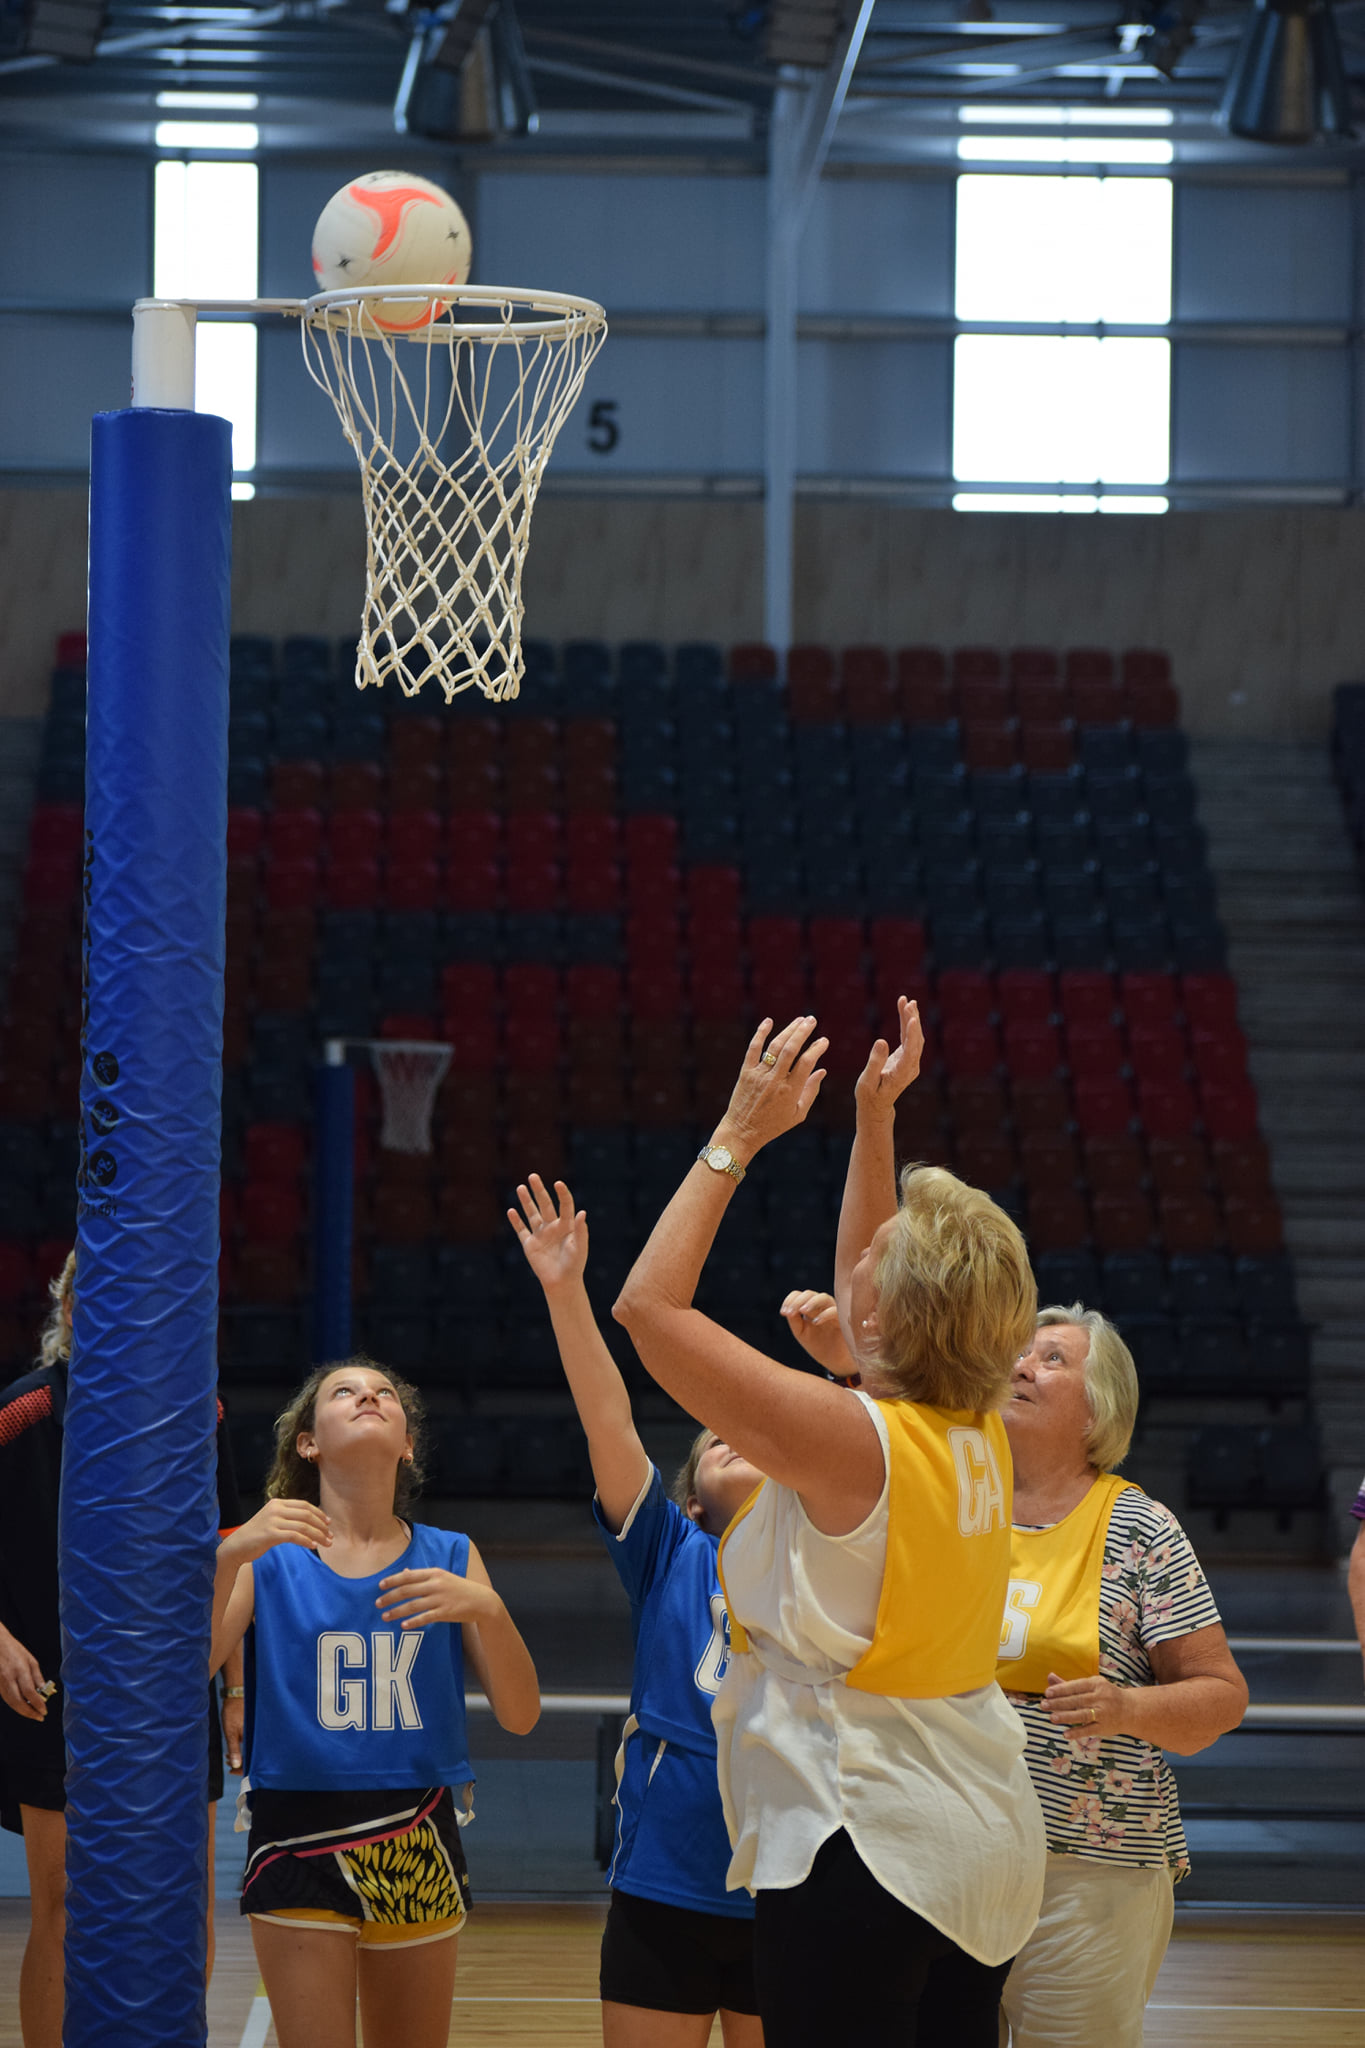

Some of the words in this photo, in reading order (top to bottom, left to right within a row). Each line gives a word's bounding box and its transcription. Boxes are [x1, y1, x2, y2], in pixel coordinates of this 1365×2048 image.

[588, 400, 620, 455] 5
[947, 1426, 1007, 1538] GA
[997, 1579, 1042, 1661] S
[317, 1631, 424, 1731] GK
